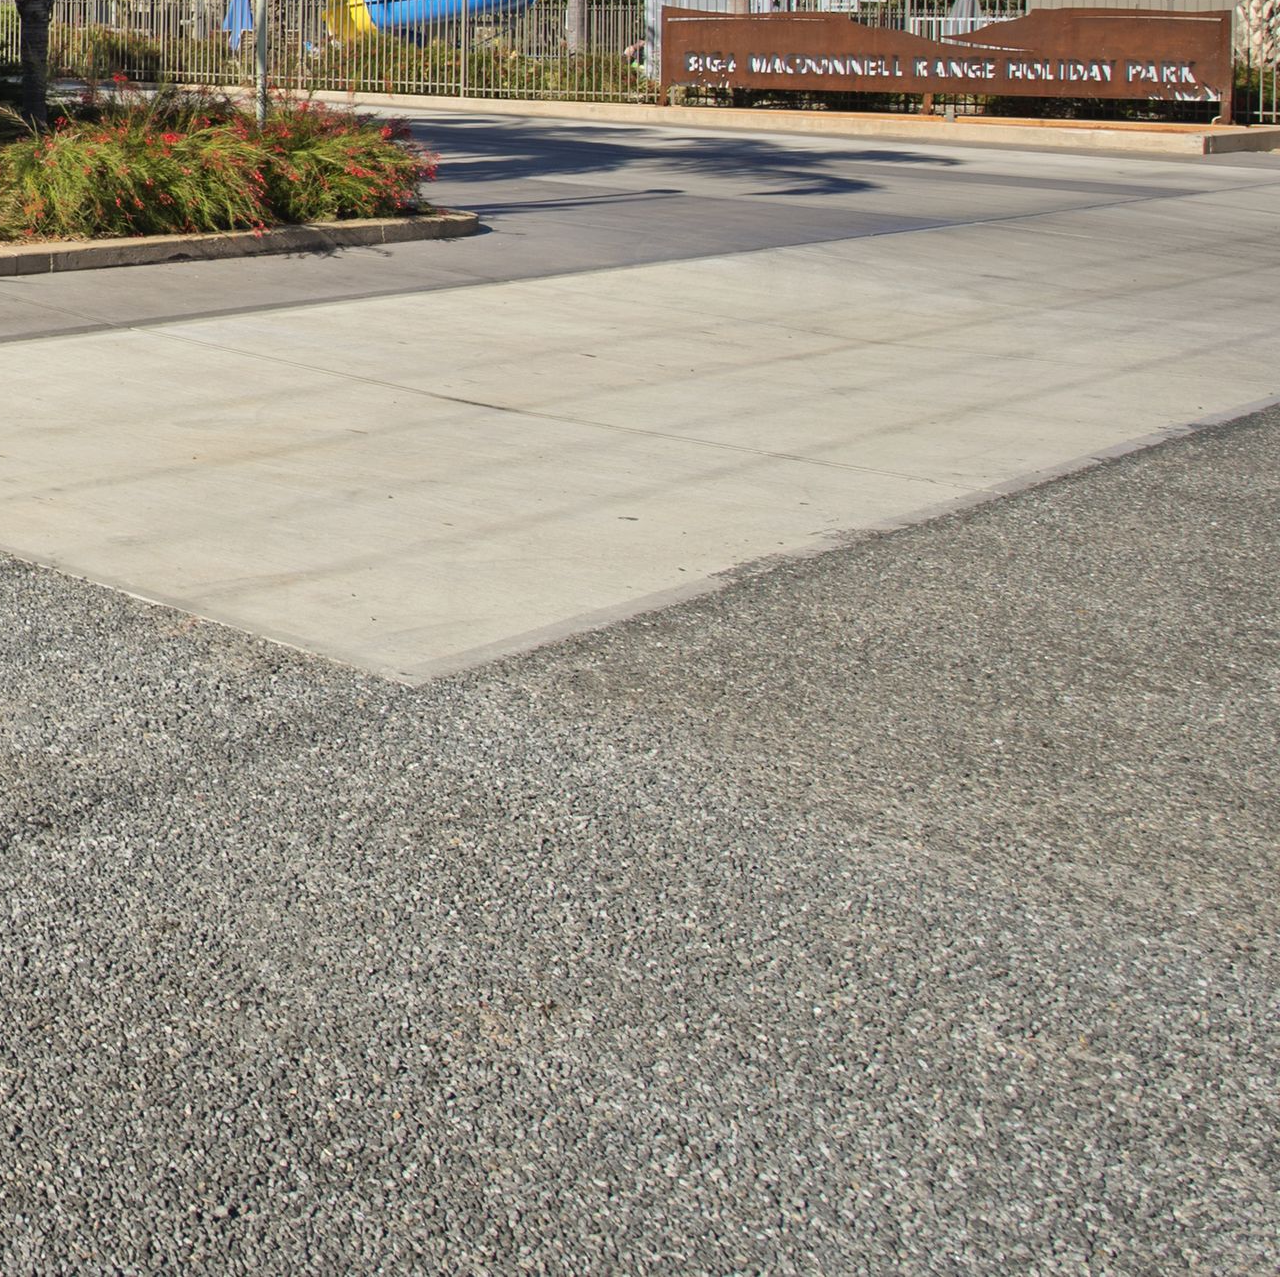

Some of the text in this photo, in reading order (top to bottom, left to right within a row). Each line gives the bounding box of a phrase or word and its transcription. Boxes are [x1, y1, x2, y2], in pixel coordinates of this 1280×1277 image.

[748, 52, 902, 76] MACDONNELL
[914, 55, 995, 79] RANGE
[1006, 58, 1115, 82] HOLIDAY
[1125, 60, 1197, 84] PARK
